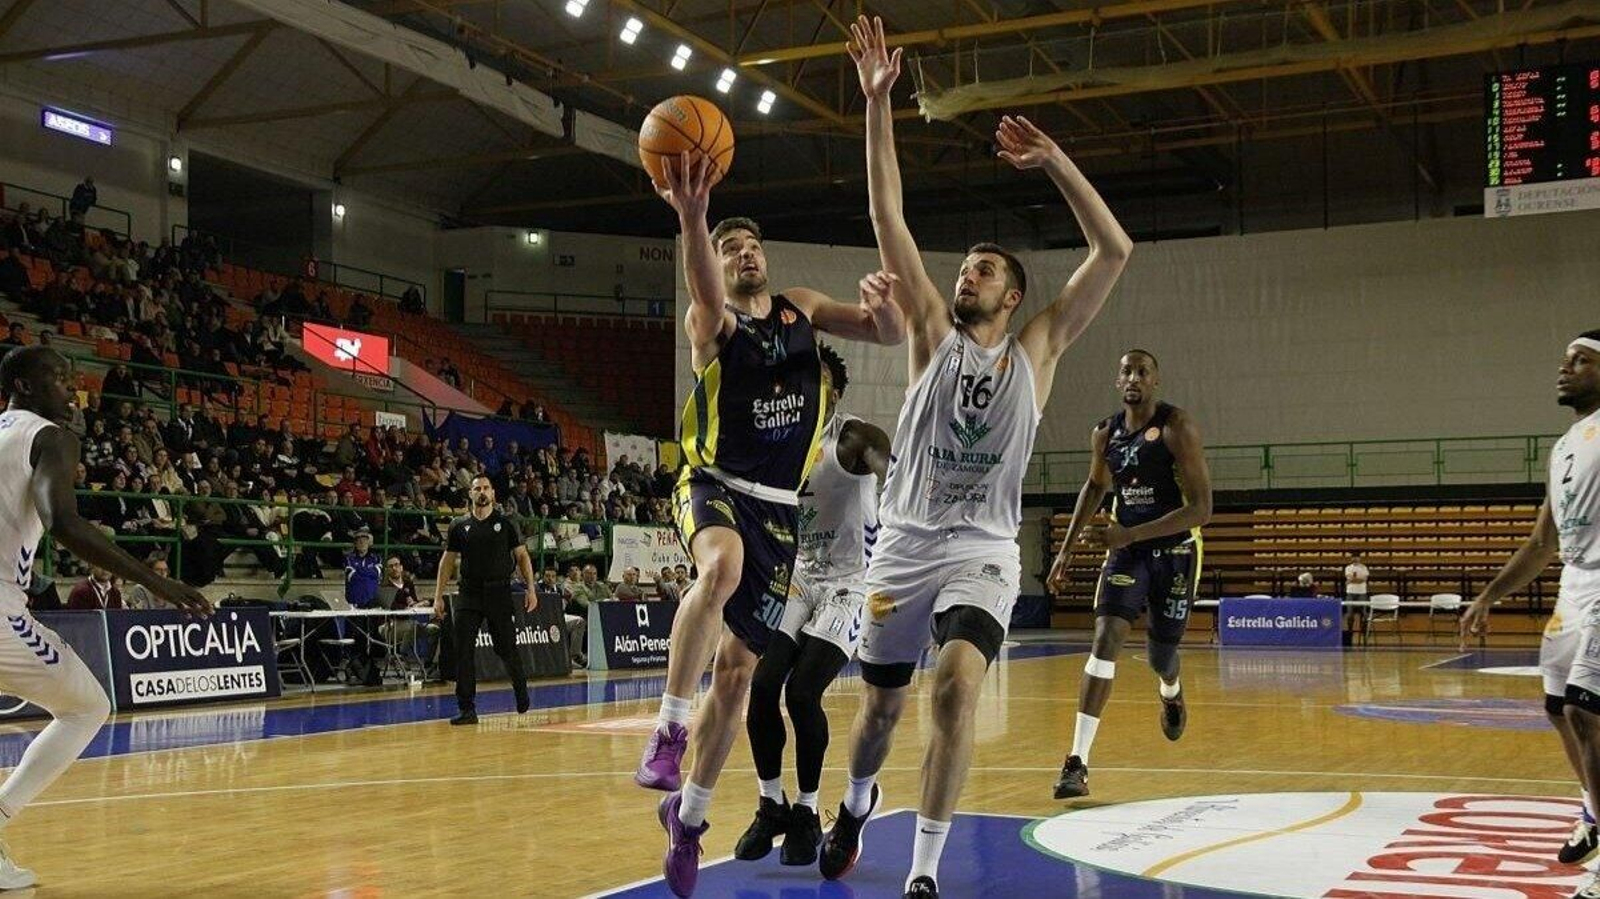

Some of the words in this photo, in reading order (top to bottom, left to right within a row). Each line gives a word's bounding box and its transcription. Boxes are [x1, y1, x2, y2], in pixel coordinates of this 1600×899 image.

[640, 246, 673, 261] NON
[960, 374, 993, 410] 16
[752, 393, 805, 414] Estrella
[753, 594, 787, 632] 30
[1163, 600, 1188, 620] 35
[1227, 616, 1273, 628] Estrella
[1275, 616, 1318, 629] Galicia
[614, 635, 640, 653] Alán
[135, 671, 262, 697] CASADELOSLENTES
